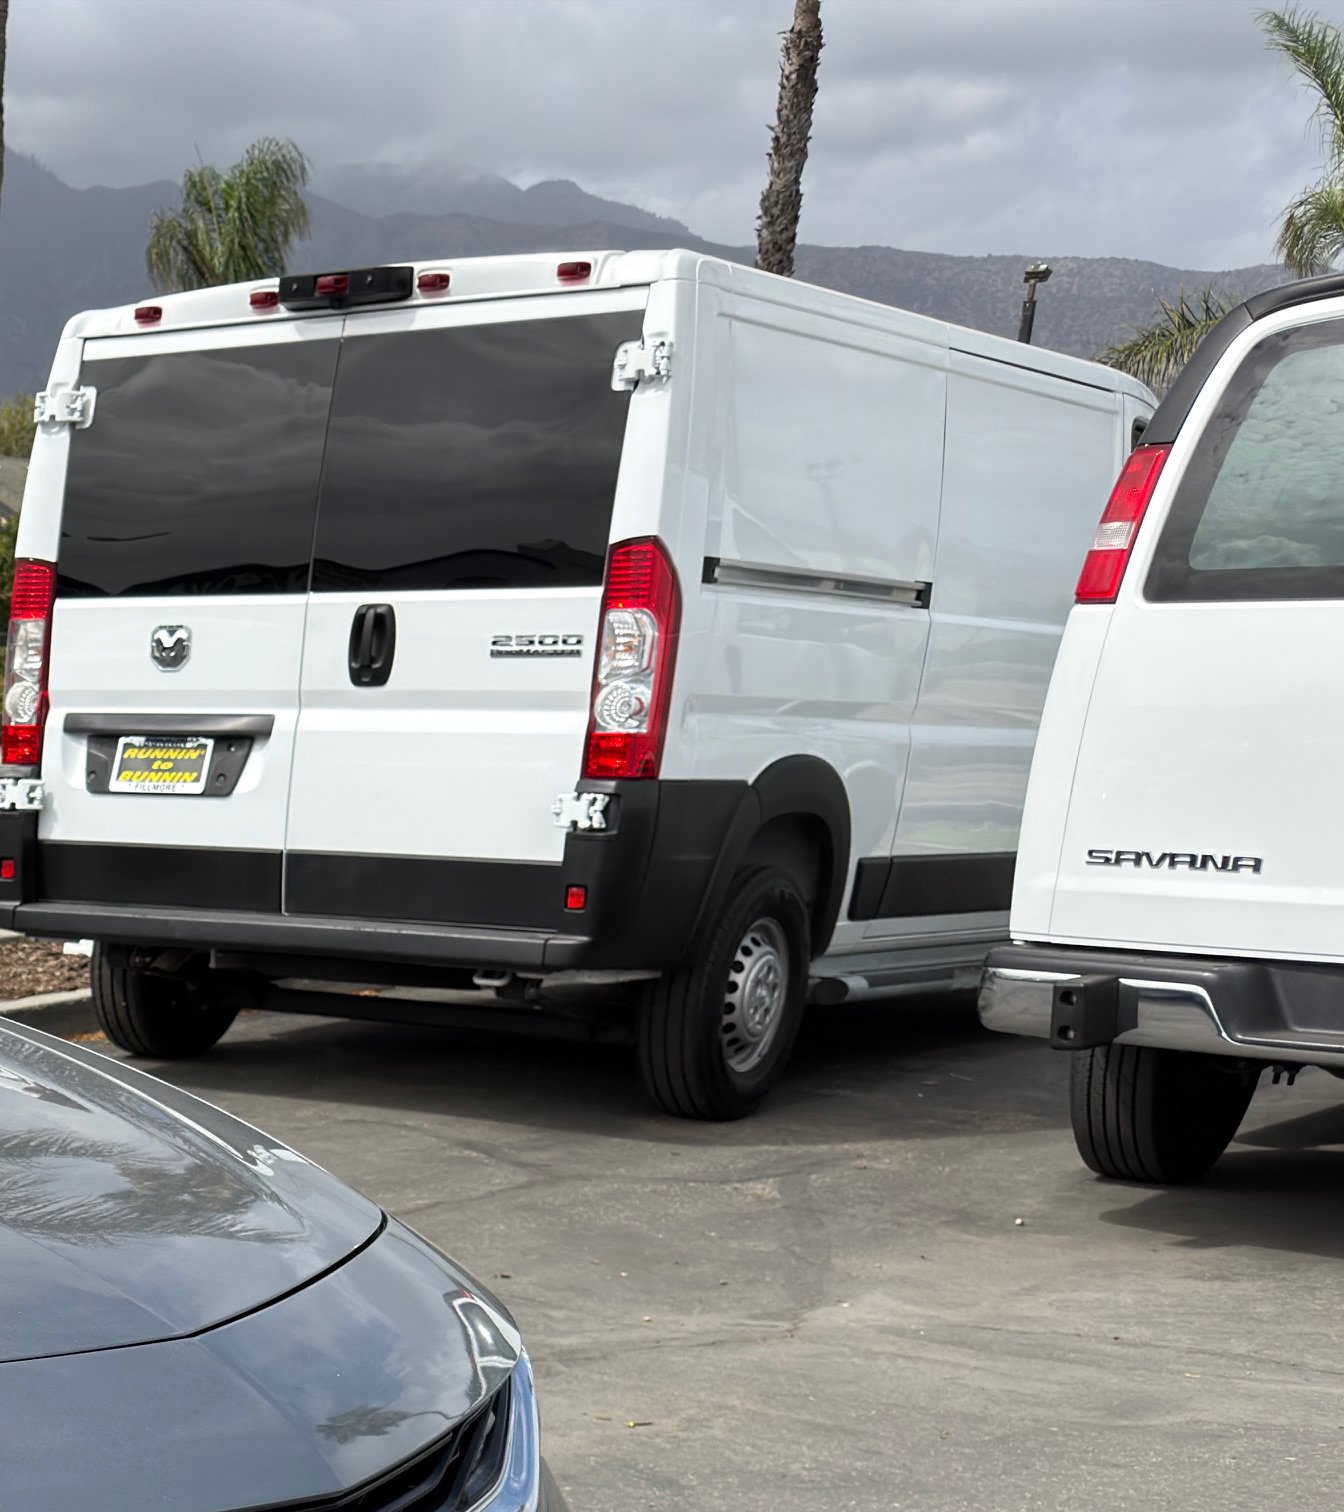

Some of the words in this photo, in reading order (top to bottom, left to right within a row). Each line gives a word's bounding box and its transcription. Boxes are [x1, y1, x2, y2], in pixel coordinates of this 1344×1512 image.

[490, 634, 584, 647] 2500
[151, 760, 174, 770] to
[117, 770, 199, 783] BUNNIN
[1085, 848, 1264, 875] SAVANA
